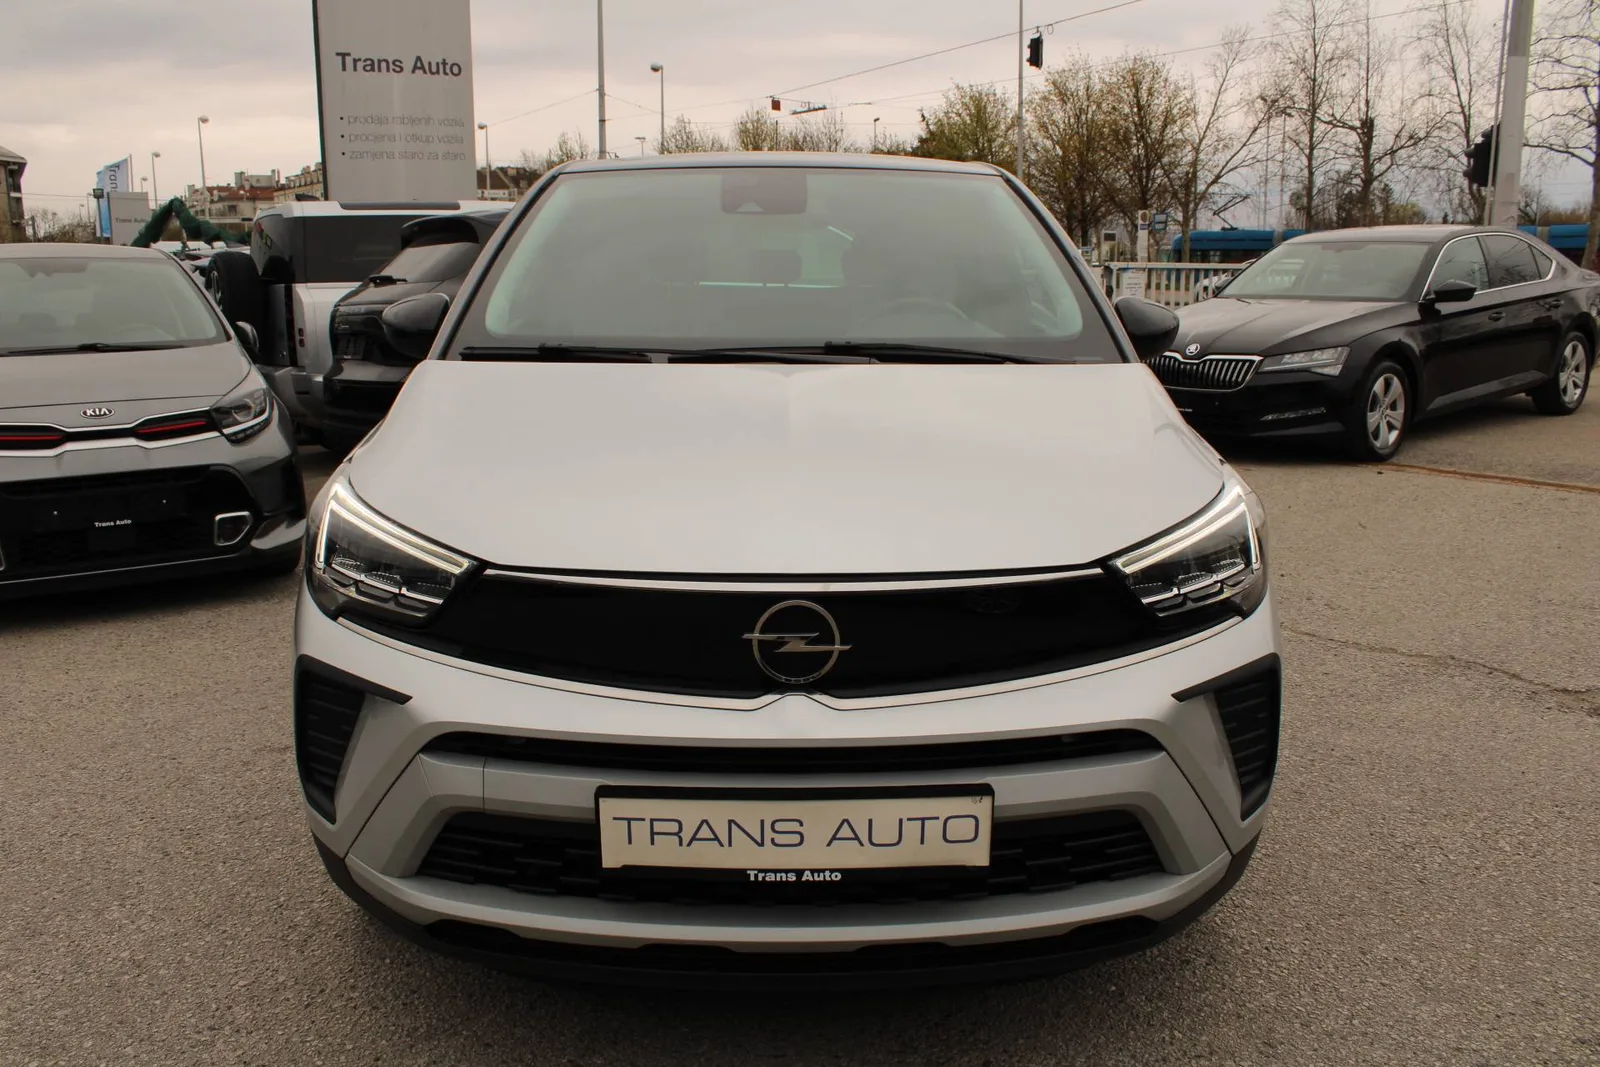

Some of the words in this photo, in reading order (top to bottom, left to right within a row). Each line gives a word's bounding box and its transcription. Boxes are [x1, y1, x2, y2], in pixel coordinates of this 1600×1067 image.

[336, 52, 404, 74] Trans
[411, 55, 462, 77] Auto
[347, 113, 389, 127] prodaja
[348, 131, 396, 144] procjena
[405, 132, 434, 144] otkup
[436, 133, 464, 144] vozila
[349, 149, 395, 161] zamjena
[398, 149, 424, 161] staro
[427, 152, 439, 160] za
[86, 408, 110, 416] KIA
[612, 816, 805, 848] TRANS
[825, 814, 981, 848] AUTO
[746, 870, 797, 882] Trans
[801, 869, 842, 882] Auto
